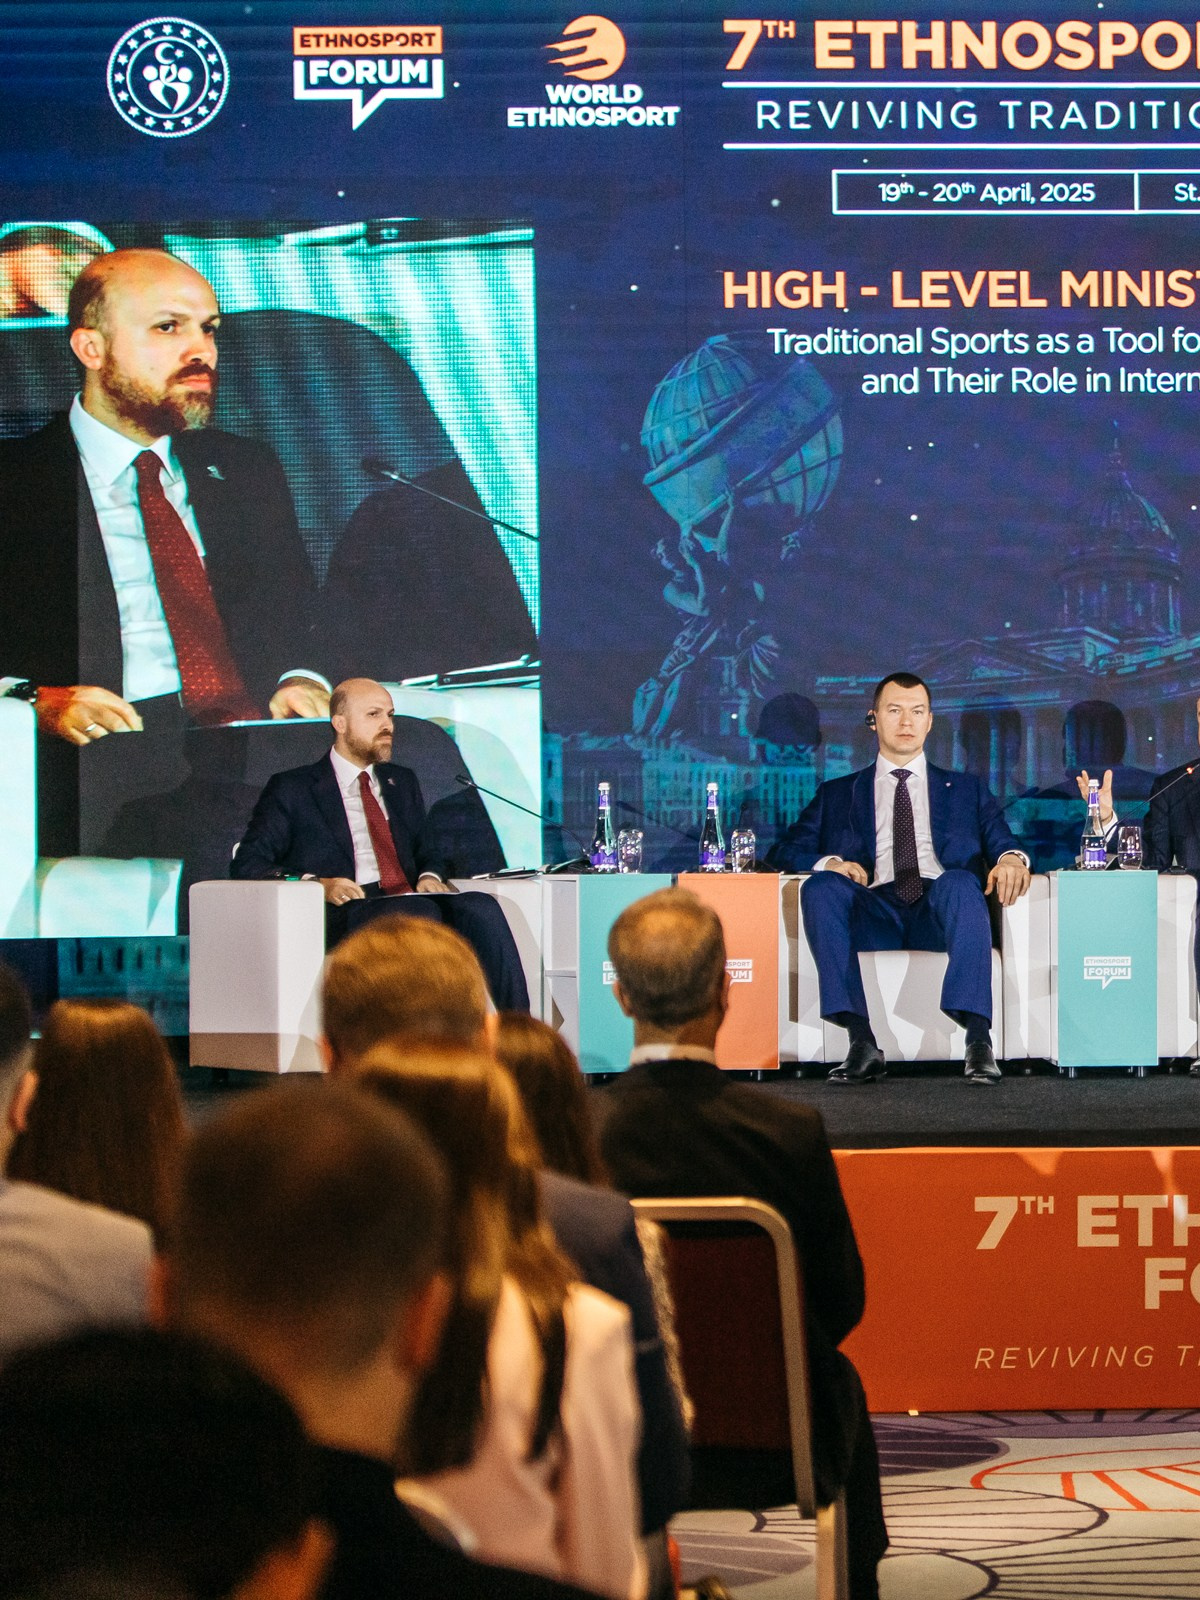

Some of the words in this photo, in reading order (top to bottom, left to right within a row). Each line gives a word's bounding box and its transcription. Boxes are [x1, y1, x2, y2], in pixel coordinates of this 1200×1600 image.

[300, 32, 436, 48] ETHNOSPORT
[723, 20, 796, 70] 7TH
[309, 59, 428, 84] FORUM
[545, 84, 643, 104] WORLD
[507, 106, 680, 127] ETHNOSPORT
[757, 101, 977, 129] REVIVING
[878, 182, 914, 201] 19th
[933, 182, 974, 201] 20th
[980, 182, 1036, 205] April,
[1041, 183, 1095, 201] 2025
[724, 272, 847, 308] HIGH
[892, 271, 1048, 308] LEVEL
[767, 326, 922, 354] Traditional
[931, 327, 1029, 359] Sports
[1036, 333, 1070, 354] as
[1077, 333, 1094, 353] a
[1103, 327, 1164, 353] Tool
[862, 367, 918, 394] and
[927, 367, 1004, 394] Their
[1012, 367, 1078, 393] Role
[1086, 367, 1111, 392] in
[1088, 968, 1127, 976] FORUM
[974, 1196, 1055, 1249] 7TH
[974, 1345, 1155, 1370] REVIVING
